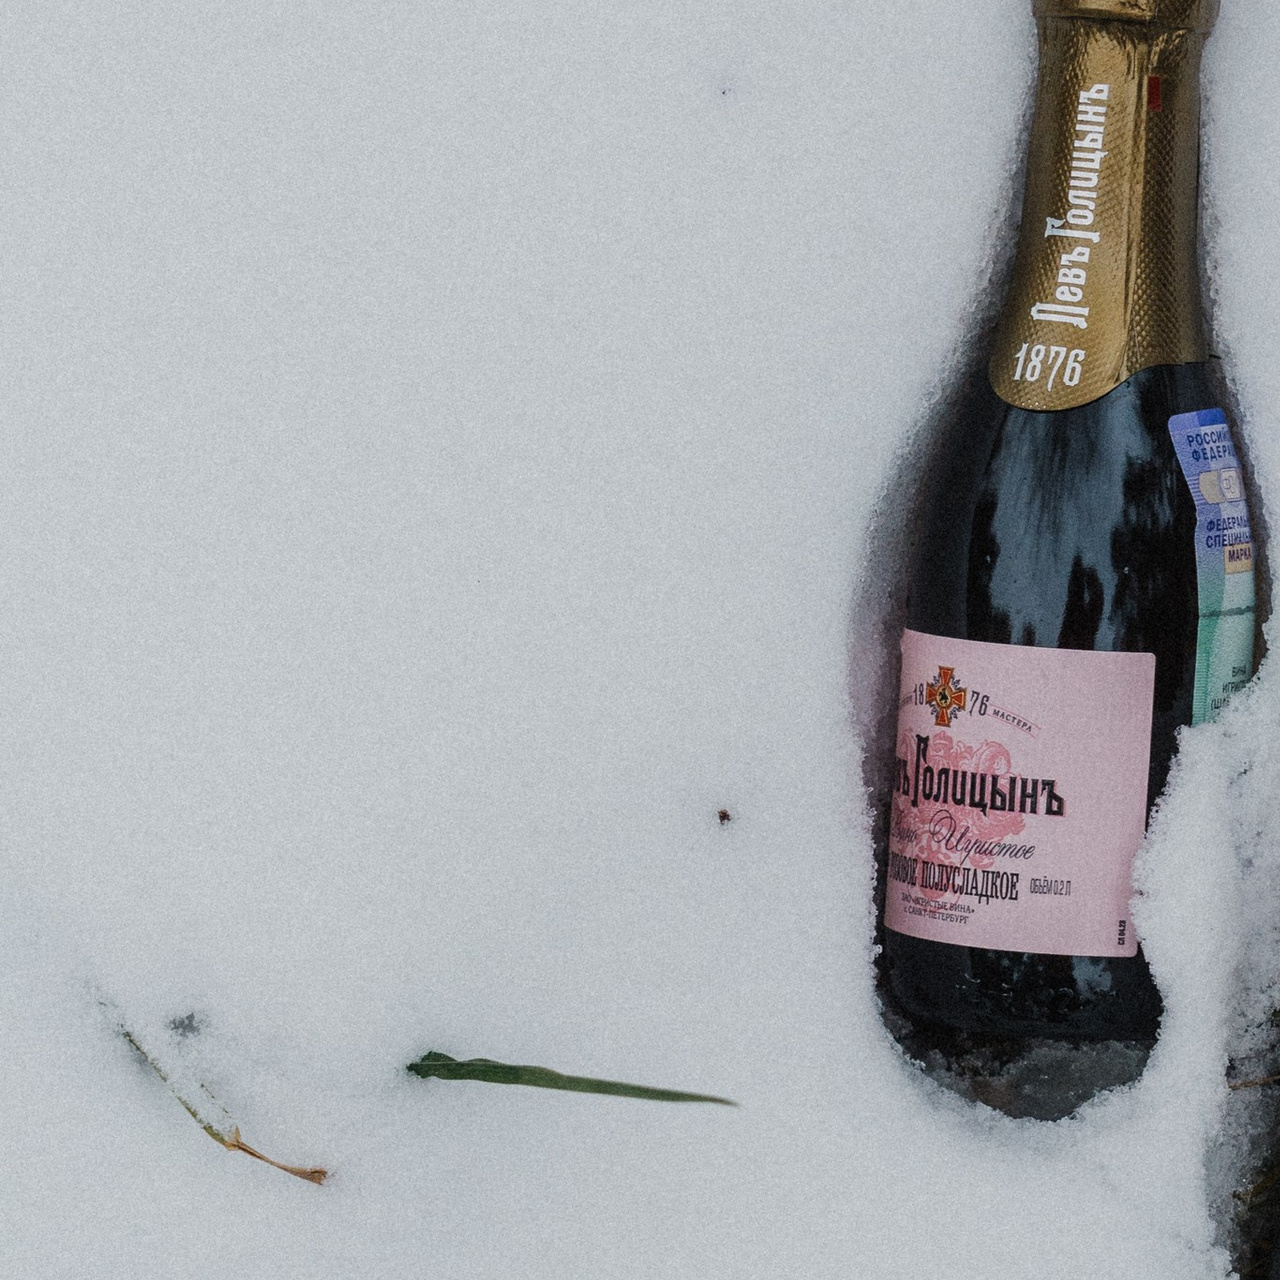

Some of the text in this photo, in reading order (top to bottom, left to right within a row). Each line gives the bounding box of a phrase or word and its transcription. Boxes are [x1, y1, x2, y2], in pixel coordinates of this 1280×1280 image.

[1030, 84, 1108, 329] Левъ Голицынъ
[1013, 343, 1086, 391] 1876
[913, 683, 925, 705] 18
[969, 690, 990, 716] 76
[992, 708, 1033, 732] МАСТЕРА
[911, 734, 1065, 817] Голицынъ
[929, 809, 1036, 865] Игристое
[921, 860, 1019, 905] ПОЛУСЛАДКОЕ
[908, 905, 970, 924] САНКТ-ПЕТЕРБУРГ
